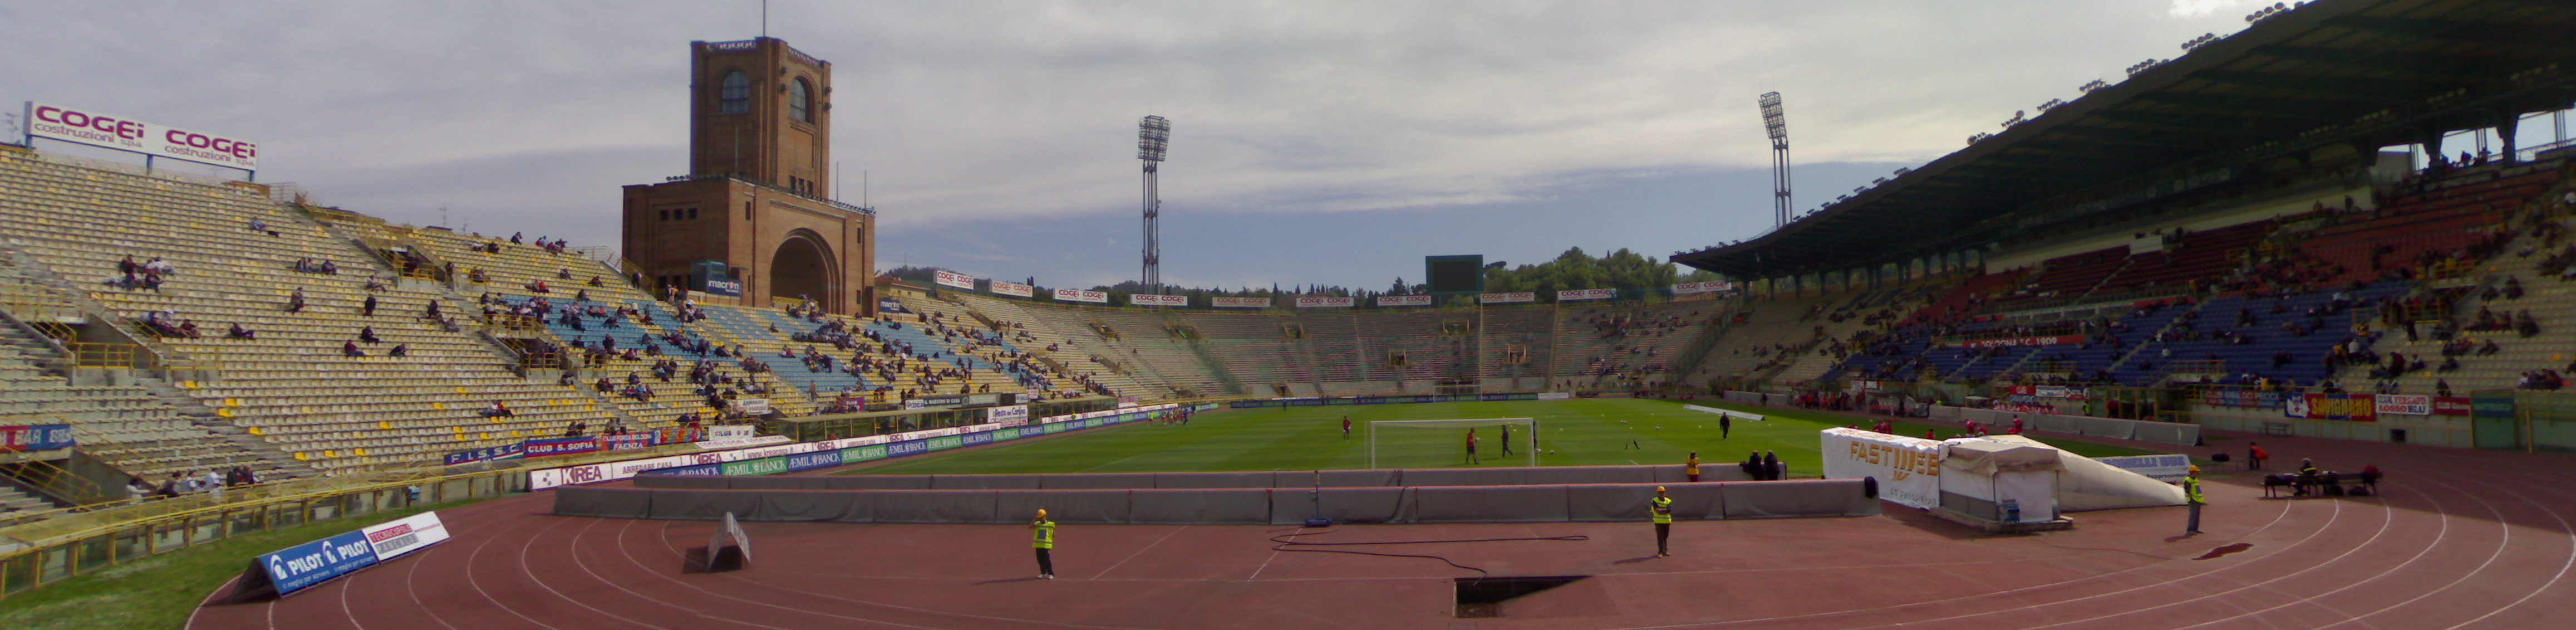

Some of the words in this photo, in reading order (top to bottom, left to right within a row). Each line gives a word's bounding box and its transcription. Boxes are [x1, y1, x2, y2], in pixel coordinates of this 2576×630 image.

[35, 123, 114, 143] costruzioni
[165, 145, 230, 162] costruzioni
[2378, 404, 2406, 413] ROSSO
[568, 441, 594, 450] SOFIA
[614, 442, 643, 451] FAENZA
[867, 446, 886, 457] BANCA
[910, 441, 927, 452] BANCA
[818, 452, 840, 463] BANCA
[1850, 440, 1939, 476] FASTWEB
[760, 458, 786, 472] BANCA
[562, 465, 603, 485] KREA
[287, 553, 325, 575] PILOT
[337, 540, 370, 560] PILOT
